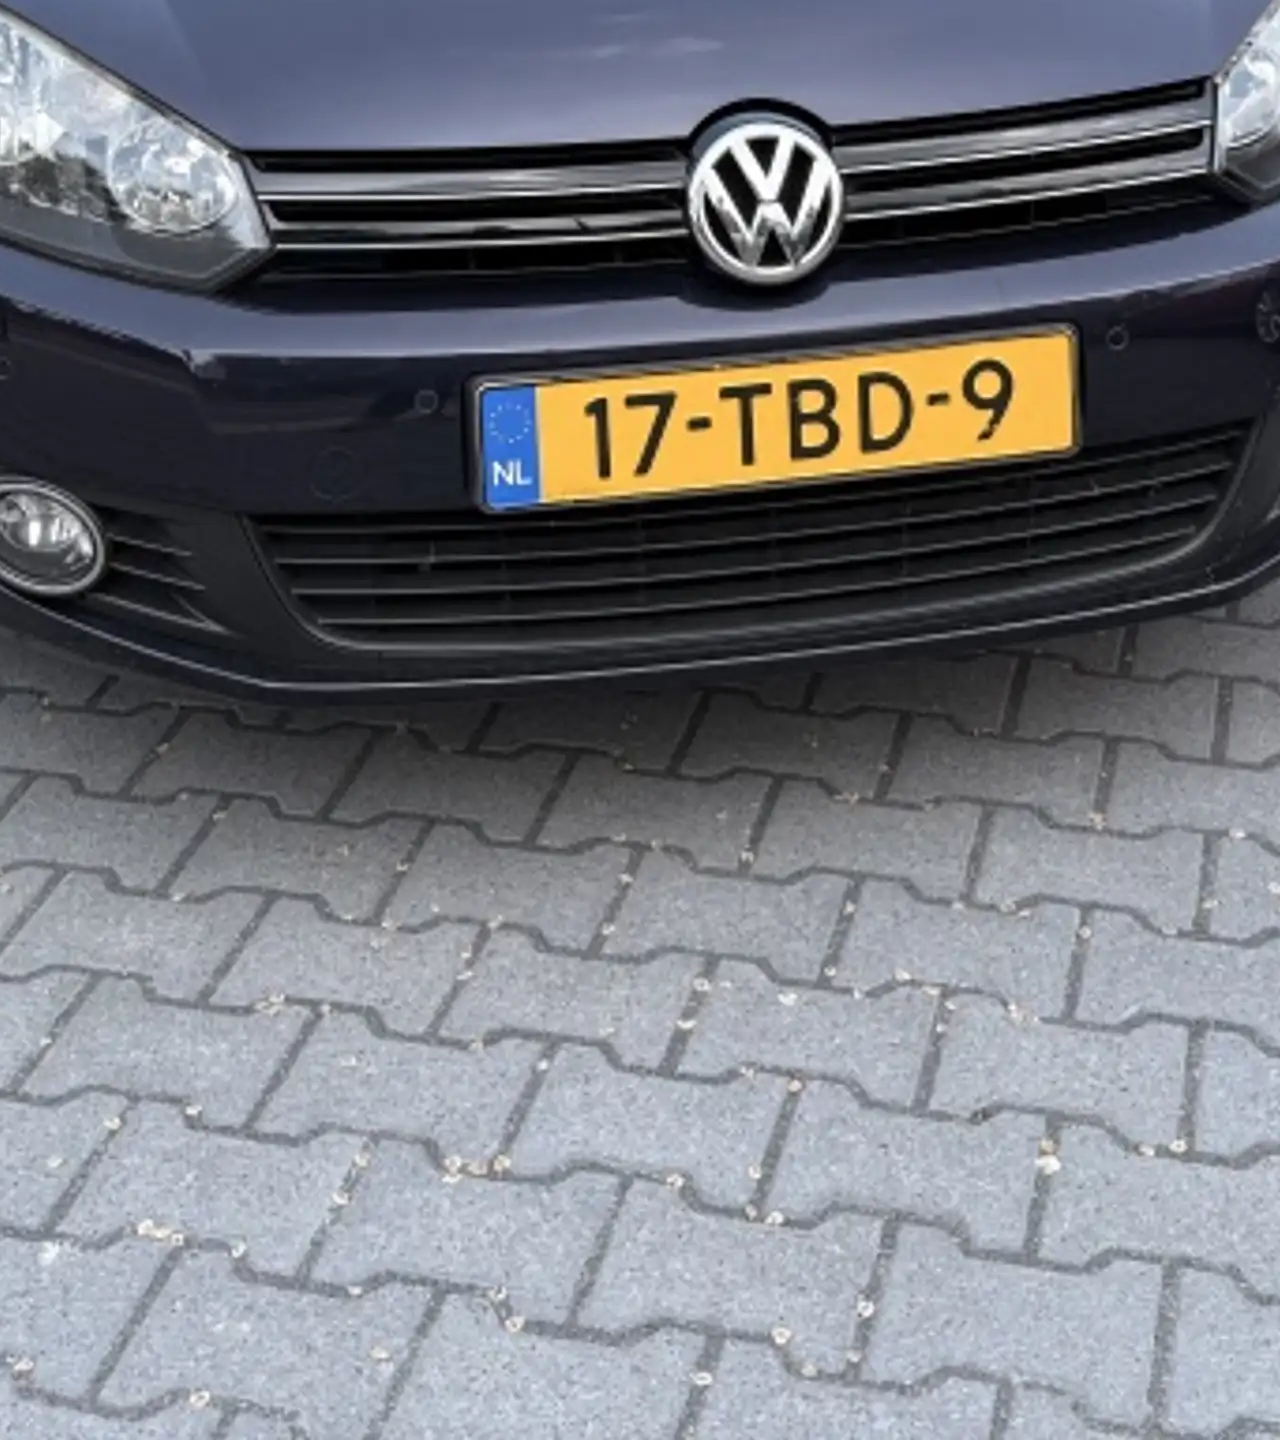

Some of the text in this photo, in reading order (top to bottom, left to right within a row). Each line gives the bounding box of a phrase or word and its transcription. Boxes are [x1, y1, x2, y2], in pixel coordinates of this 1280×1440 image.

[689, 124, 843, 283] VW
[492, 358, 1014, 486] NL 17-TBD-9
